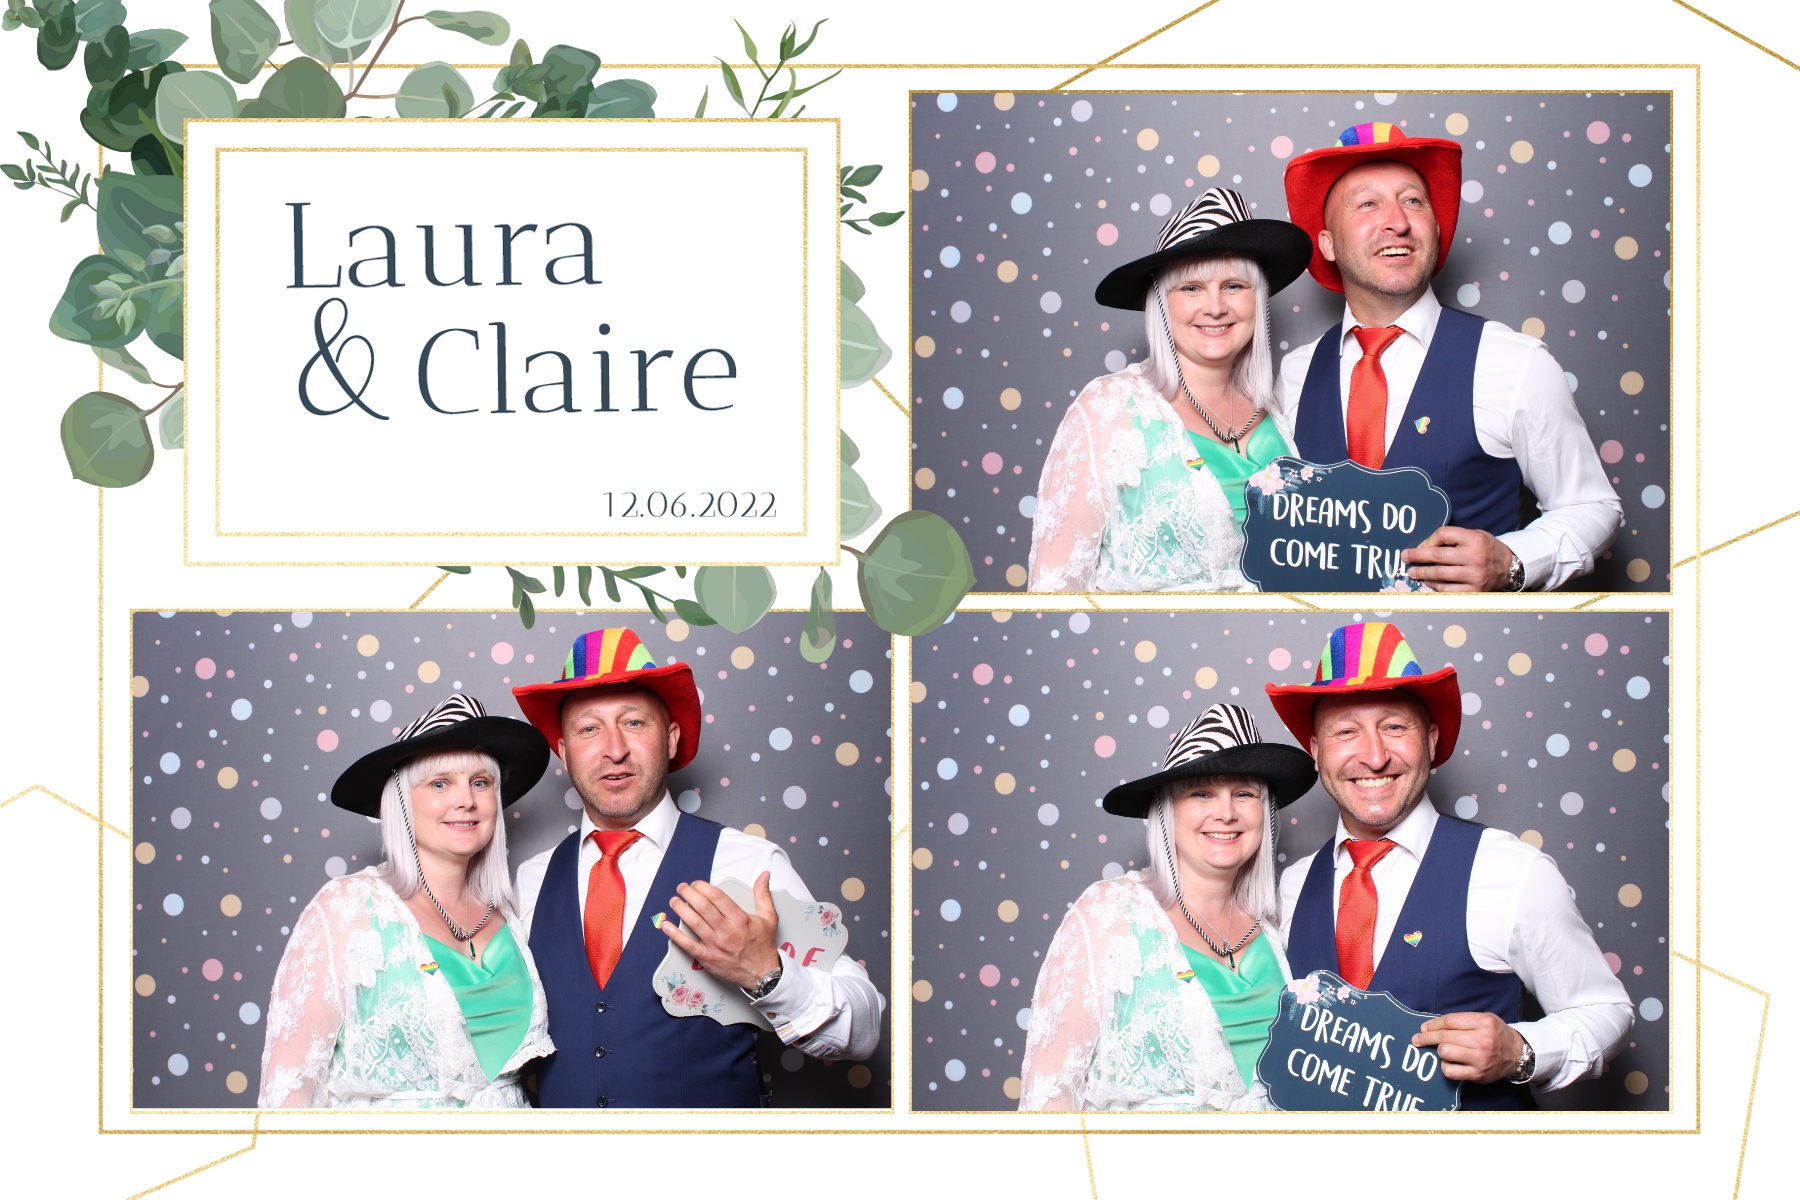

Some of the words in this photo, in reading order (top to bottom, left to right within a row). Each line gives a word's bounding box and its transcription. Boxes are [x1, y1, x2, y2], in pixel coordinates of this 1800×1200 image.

[1273, 493, 1372, 534] DREAMS
[1382, 503, 1417, 534] DO
[1270, 538, 1340, 570] COME
[1301, 1005, 1396, 1069] DREAMS
[1402, 1044, 1438, 1081] DO
[1287, 1048, 1356, 1096] COME
